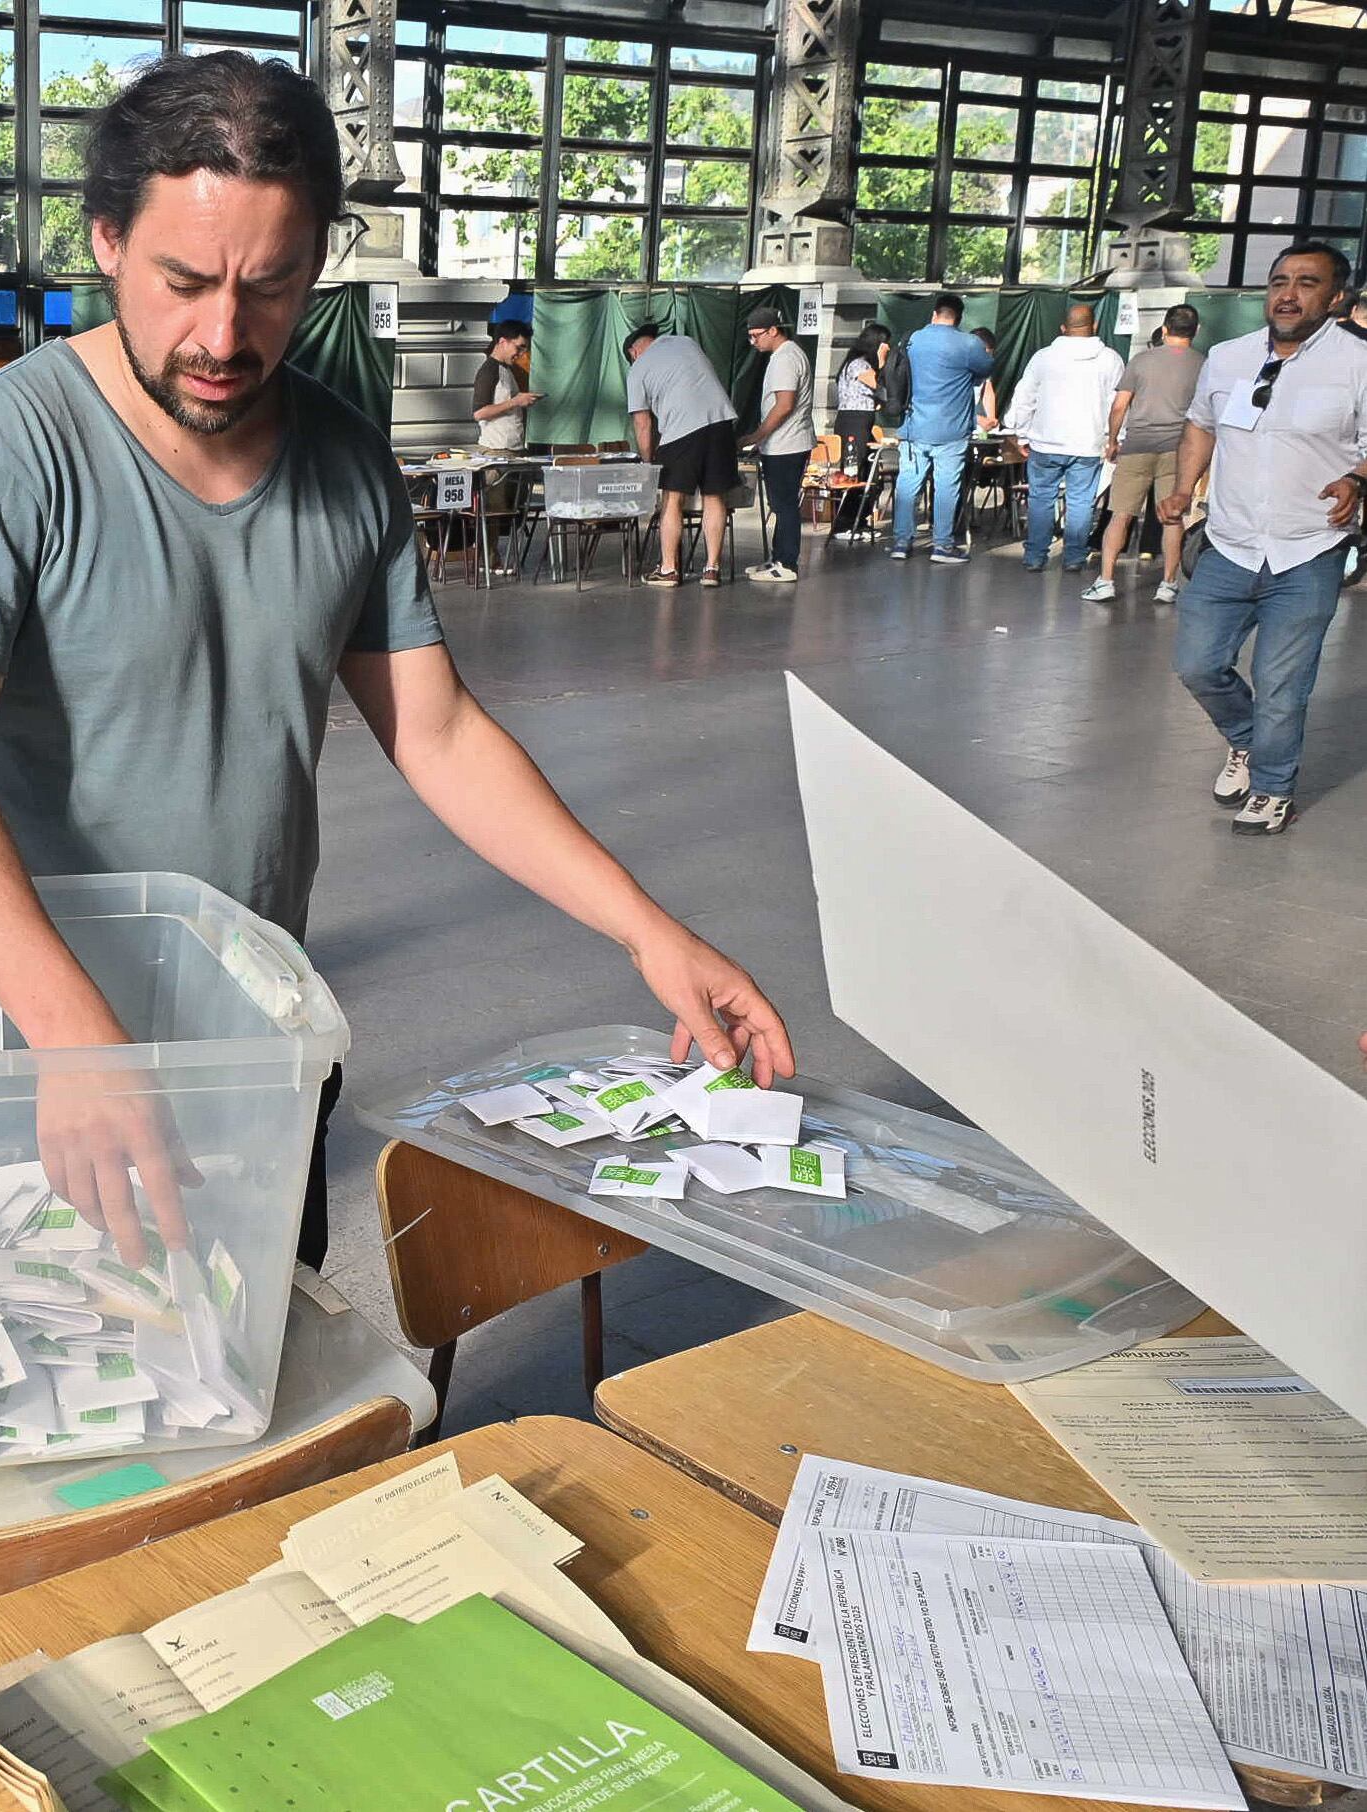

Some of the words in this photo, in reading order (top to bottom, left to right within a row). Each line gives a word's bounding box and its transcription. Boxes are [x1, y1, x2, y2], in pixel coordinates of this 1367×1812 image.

[376, 302, 391, 311] MESA
[375, 313, 391, 328] 958
[803, 313, 818, 327] 959
[445, 475, 465, 485] MESA
[444, 489, 464, 502] 958
[413, 1465, 450, 1488] ELECTORAL
[784, 1584, 802, 1622] ELECCIONES
[840, 1608, 850, 1619] LA
[851, 1604, 862, 1623] 2025
[842, 1618, 852, 1629] DE
[923, 1616, 936, 1643] ASISTIDO
[843, 1627, 861, 1674] PRESIDENTE
[854, 1623, 875, 1691] PARLAMENTARIOS
[933, 1658, 943, 1668] DE
[851, 1673, 863, 1687] DE
[936, 1667, 946, 1681] USO
[939, 1680, 952, 1704] SOBRE
[854, 1687, 872, 1738] ELECCIONES
[944, 1703, 959, 1733] INFORME
